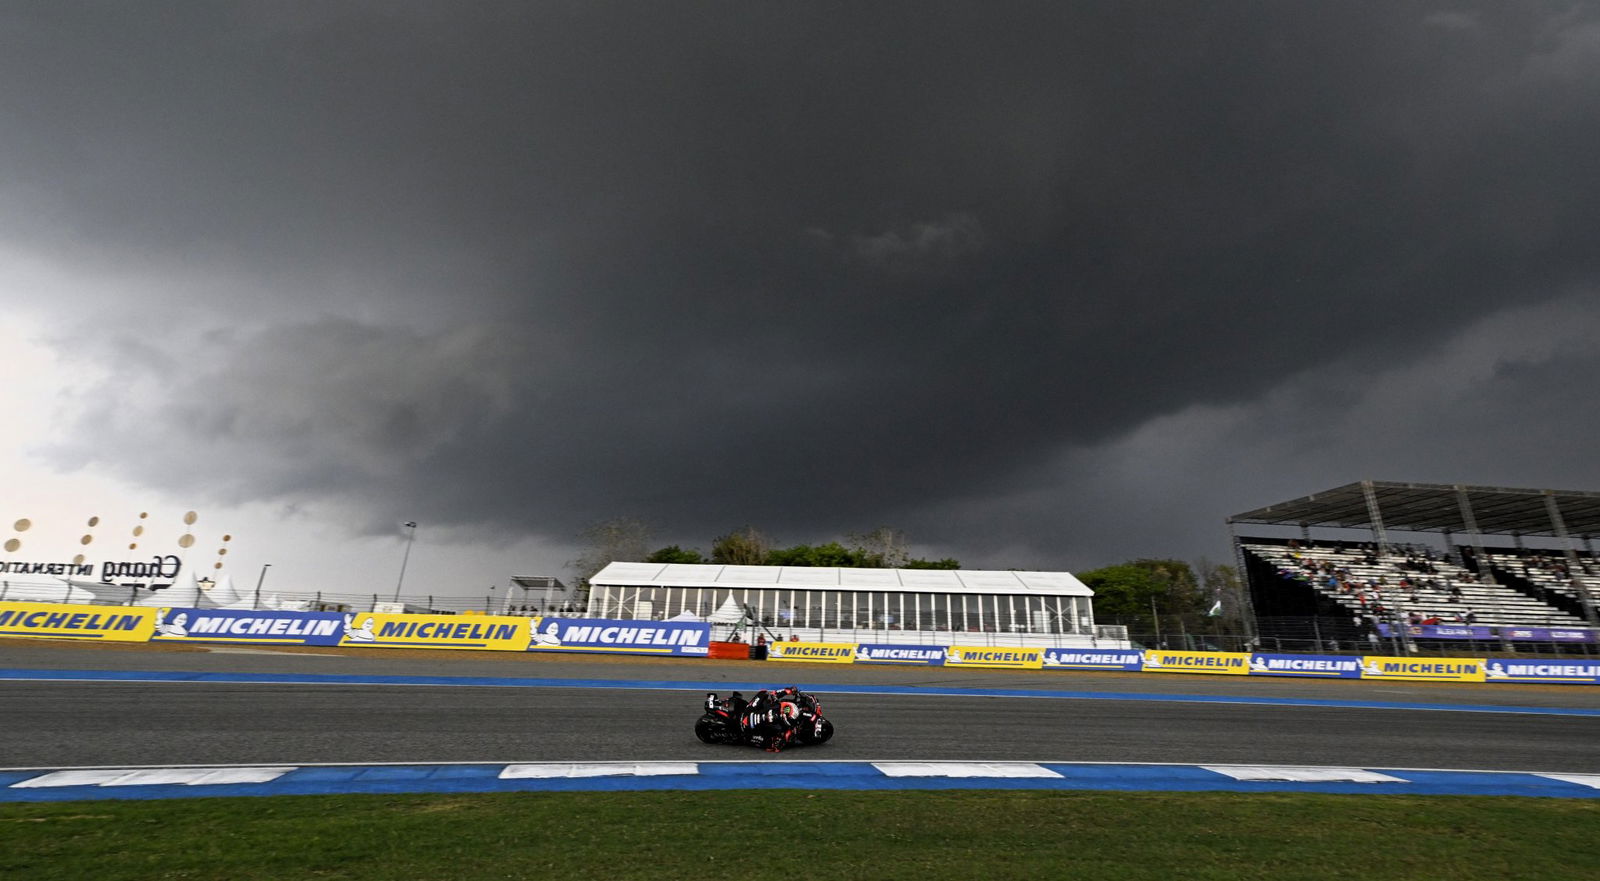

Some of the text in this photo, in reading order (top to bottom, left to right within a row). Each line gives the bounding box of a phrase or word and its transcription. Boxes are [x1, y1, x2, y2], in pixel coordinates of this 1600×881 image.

[190, 615, 341, 637] MICHELIN
[379, 621, 519, 640] MICHELIN
[562, 626, 703, 646] MICHELIN
[785, 646, 854, 658] MICHELIN
[871, 648, 943, 661] MICHELIN
[963, 651, 1039, 663] MICHELIN
[1059, 653, 1139, 665] MICHELIN
[1162, 656, 1244, 668] MICHELIN
[1268, 659, 1357, 671] MICHELIN
[1383, 662, 1477, 674] MICHELIN
